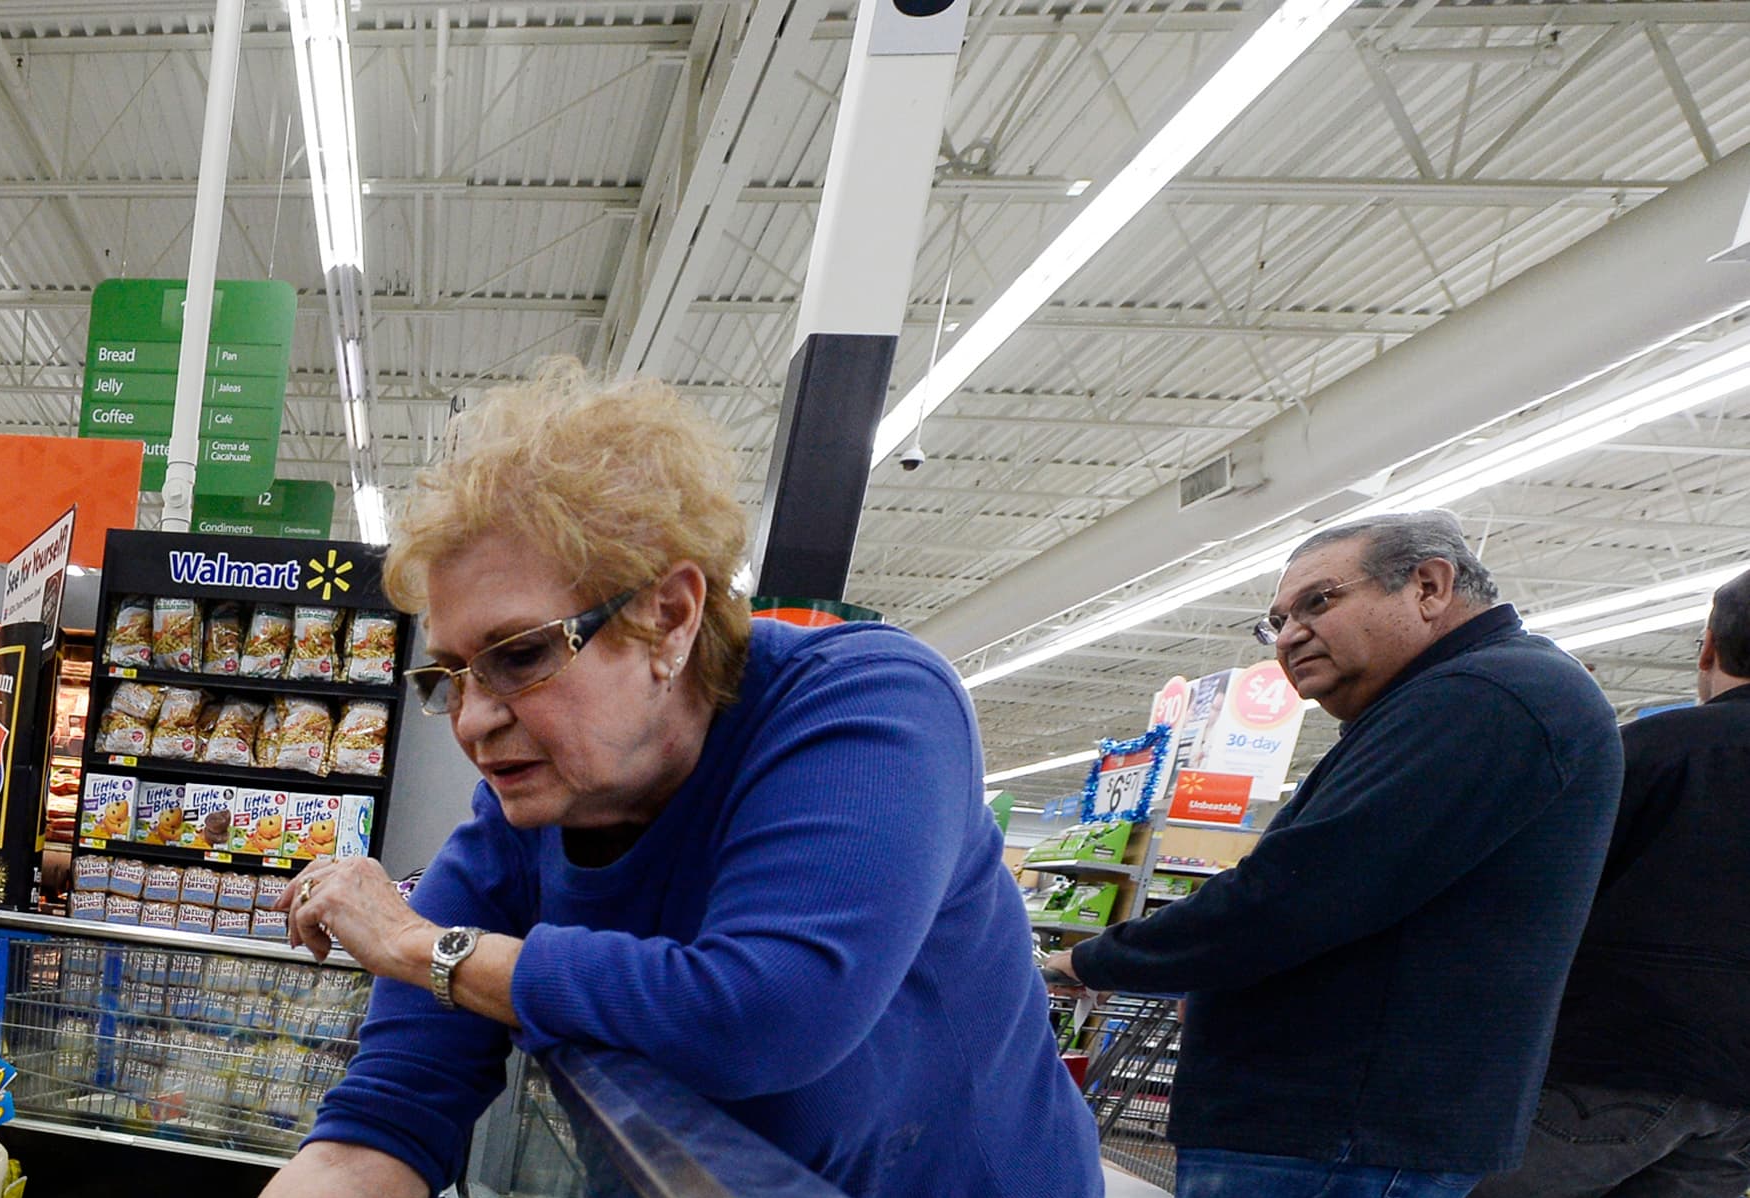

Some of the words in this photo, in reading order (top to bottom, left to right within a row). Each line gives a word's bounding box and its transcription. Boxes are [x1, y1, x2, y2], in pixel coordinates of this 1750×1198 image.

[98, 347, 136, 362] Bread
[221, 351, 238, 362] Pan
[93, 378, 124, 397] Jelly
[218, 383, 242, 394] Jaleas
[92, 408, 135, 424] Coffee
[214, 413, 234, 425] Café
[211, 440, 237, 451] Crema
[238, 441, 250, 451] de
[210, 451, 252, 463] Cacahuate
[199, 521, 254, 535] Condiments
[6, 569, 20, 597] See
[20, 557, 32, 587] for
[169, 551, 302, 591] Walmart
[1246, 674, 1288, 714] $4
[1157, 693, 1182, 726] $10
[1225, 732, 1282, 754] 30-day
[93, 779, 119, 797] Little
[146, 787, 173, 805] Little
[99, 790, 128, 806] Bites
[153, 797, 180, 813] Bites
[193, 788, 220, 807] Little
[244, 794, 271, 812] Little
[200, 800, 229, 815] Bites
[251, 805, 279, 820] Bites
[296, 798, 324, 817] Little
[303, 810, 332, 825] Bites
